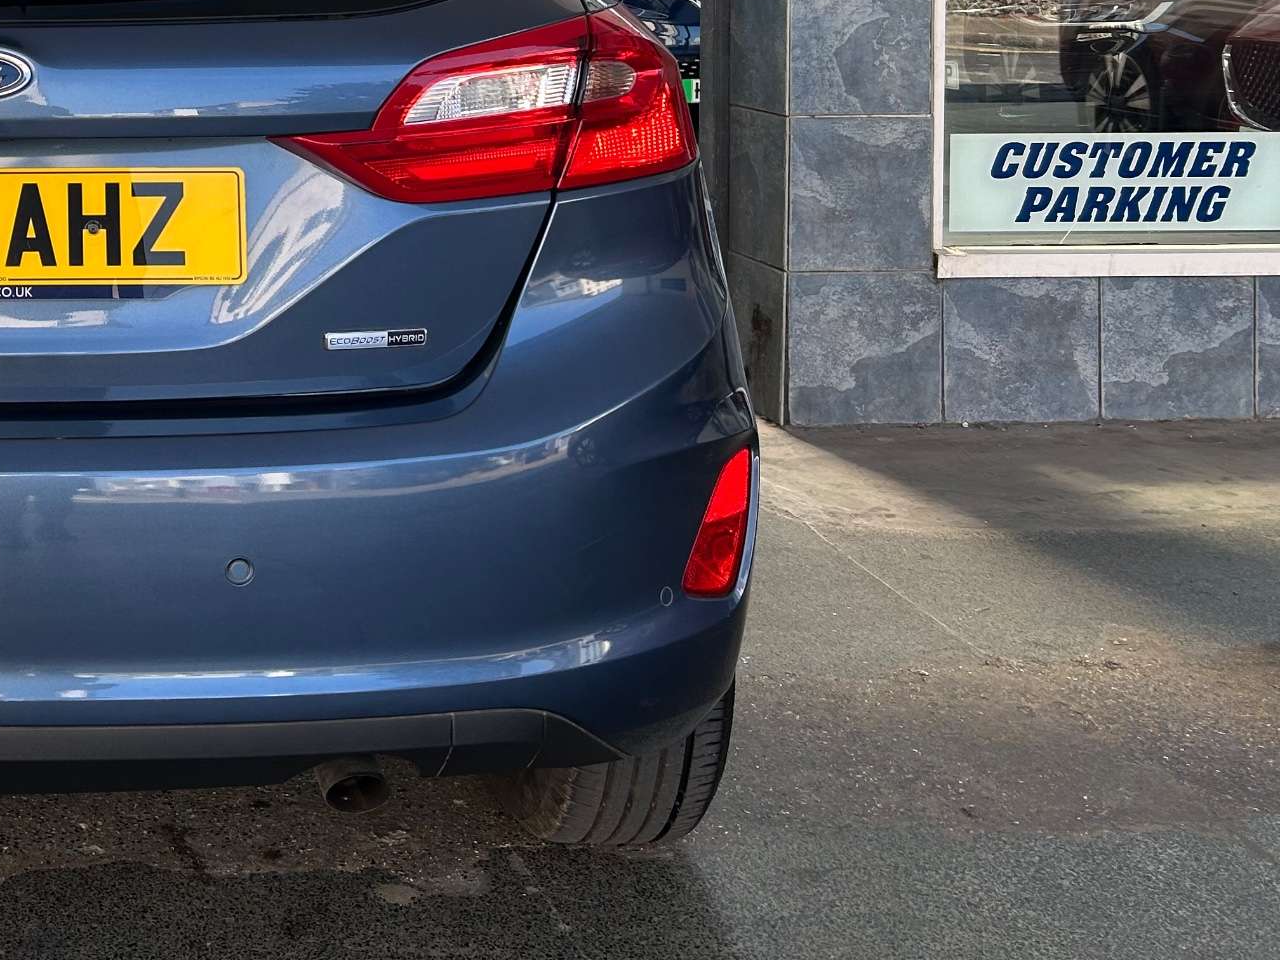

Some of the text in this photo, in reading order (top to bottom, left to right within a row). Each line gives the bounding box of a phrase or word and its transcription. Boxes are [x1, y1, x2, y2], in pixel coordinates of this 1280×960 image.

[990, 141, 1257, 179] CUSTOMER
[1014, 185, 1231, 223] PARKING
[5, 181, 186, 267] AHZ
[388, 333, 425, 343] HYBRID
